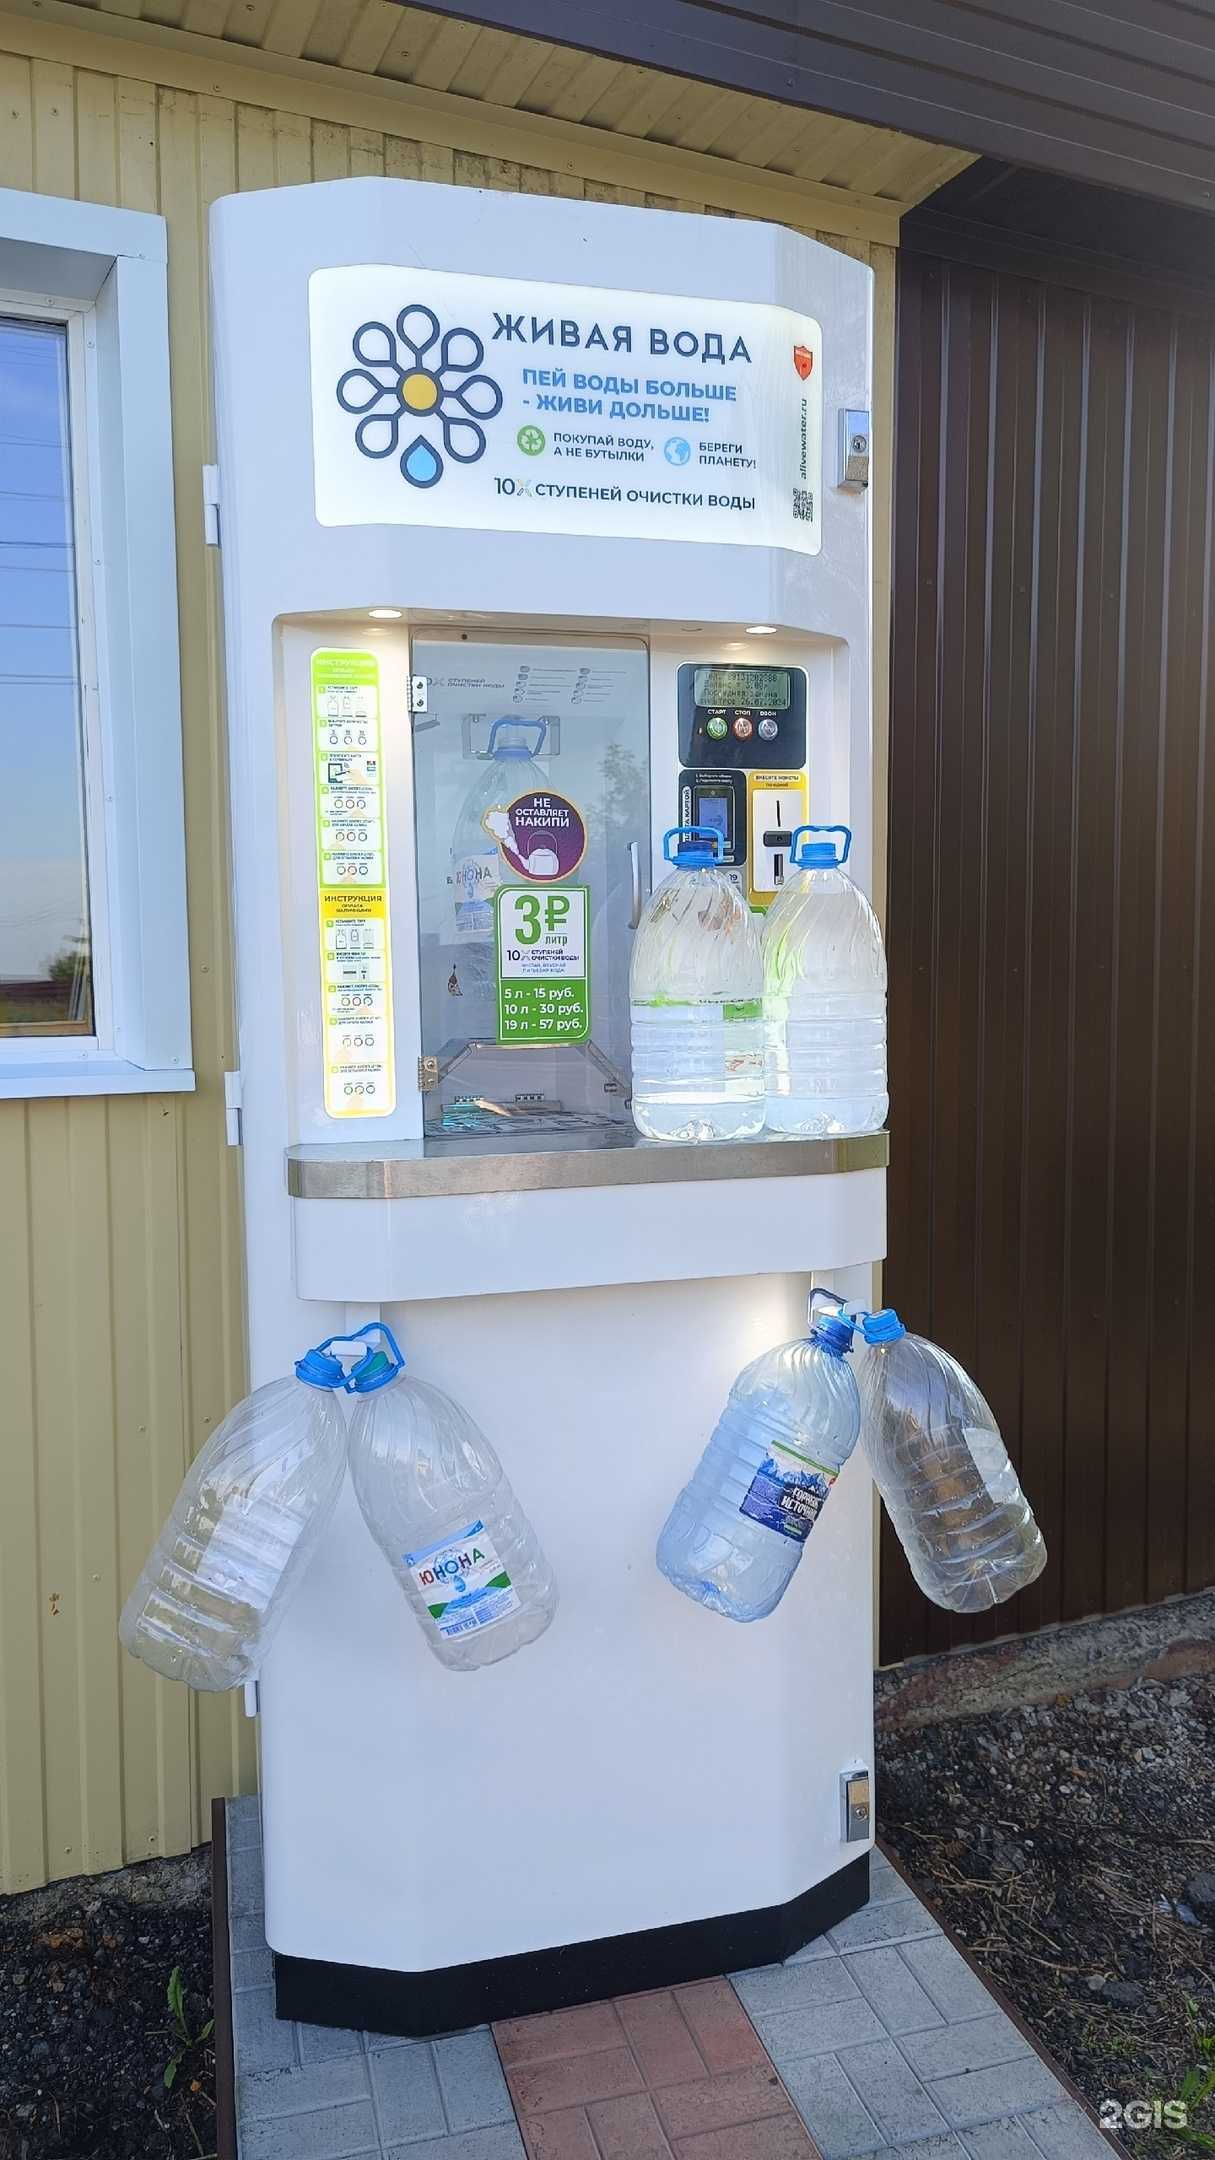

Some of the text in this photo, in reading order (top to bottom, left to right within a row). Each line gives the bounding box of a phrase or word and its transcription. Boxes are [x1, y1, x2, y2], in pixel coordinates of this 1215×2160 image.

[491, 312, 752, 365] ЖИВАЯ ВОДА
[522, 367, 737, 402] ПЕЙ ВОДЫ БОЛЬШЕ
[536, 393, 603, 416] ЖИВИ
[609, 399, 710, 424] ДОЛЬШЕ!
[553, 432, 655, 451] ПОКУПАЙ ВОДУ,
[800, 398, 808, 480] alivewater.ru
[553, 446, 645, 463] А НЕ БУТЫЛКИ
[698, 441, 743, 455] БЕРЕГИ
[698, 454, 757, 470] ПЛАНЕТУ!
[535, 482, 622, 502] СТУПЕНЕЙ
[626, 489, 703, 506] ОЧИСТКИ
[707, 494, 756, 511] ВОДЫ
[533, 797, 551, 808] НЕ
[515, 808, 569, 817] ОСТАВЛЯЕТ
[515, 816, 570, 828] НАКИПИ
[324, 895, 383, 903] ИНСТРУКЦИЯ
[545, 935, 568, 947] литр
[504, 988, 512, 999] 5
[514, 990, 523, 999] л
[533, 987, 546, 998] 15
[549, 987, 575, 1001] руб.
[504, 1003, 518, 1014] 10
[520, 1005, 529, 1014] л
[539, 1003, 555, 1014] 30
[558, 1002, 584, 1016] руб.
[504, 1020, 518, 1030] 19
[520, 1021, 528, 1030] л
[539, 1019, 554, 1030] 57
[556, 1018, 583, 1031] руб.
[418, 1547, 486, 1586] ЮНОНА
